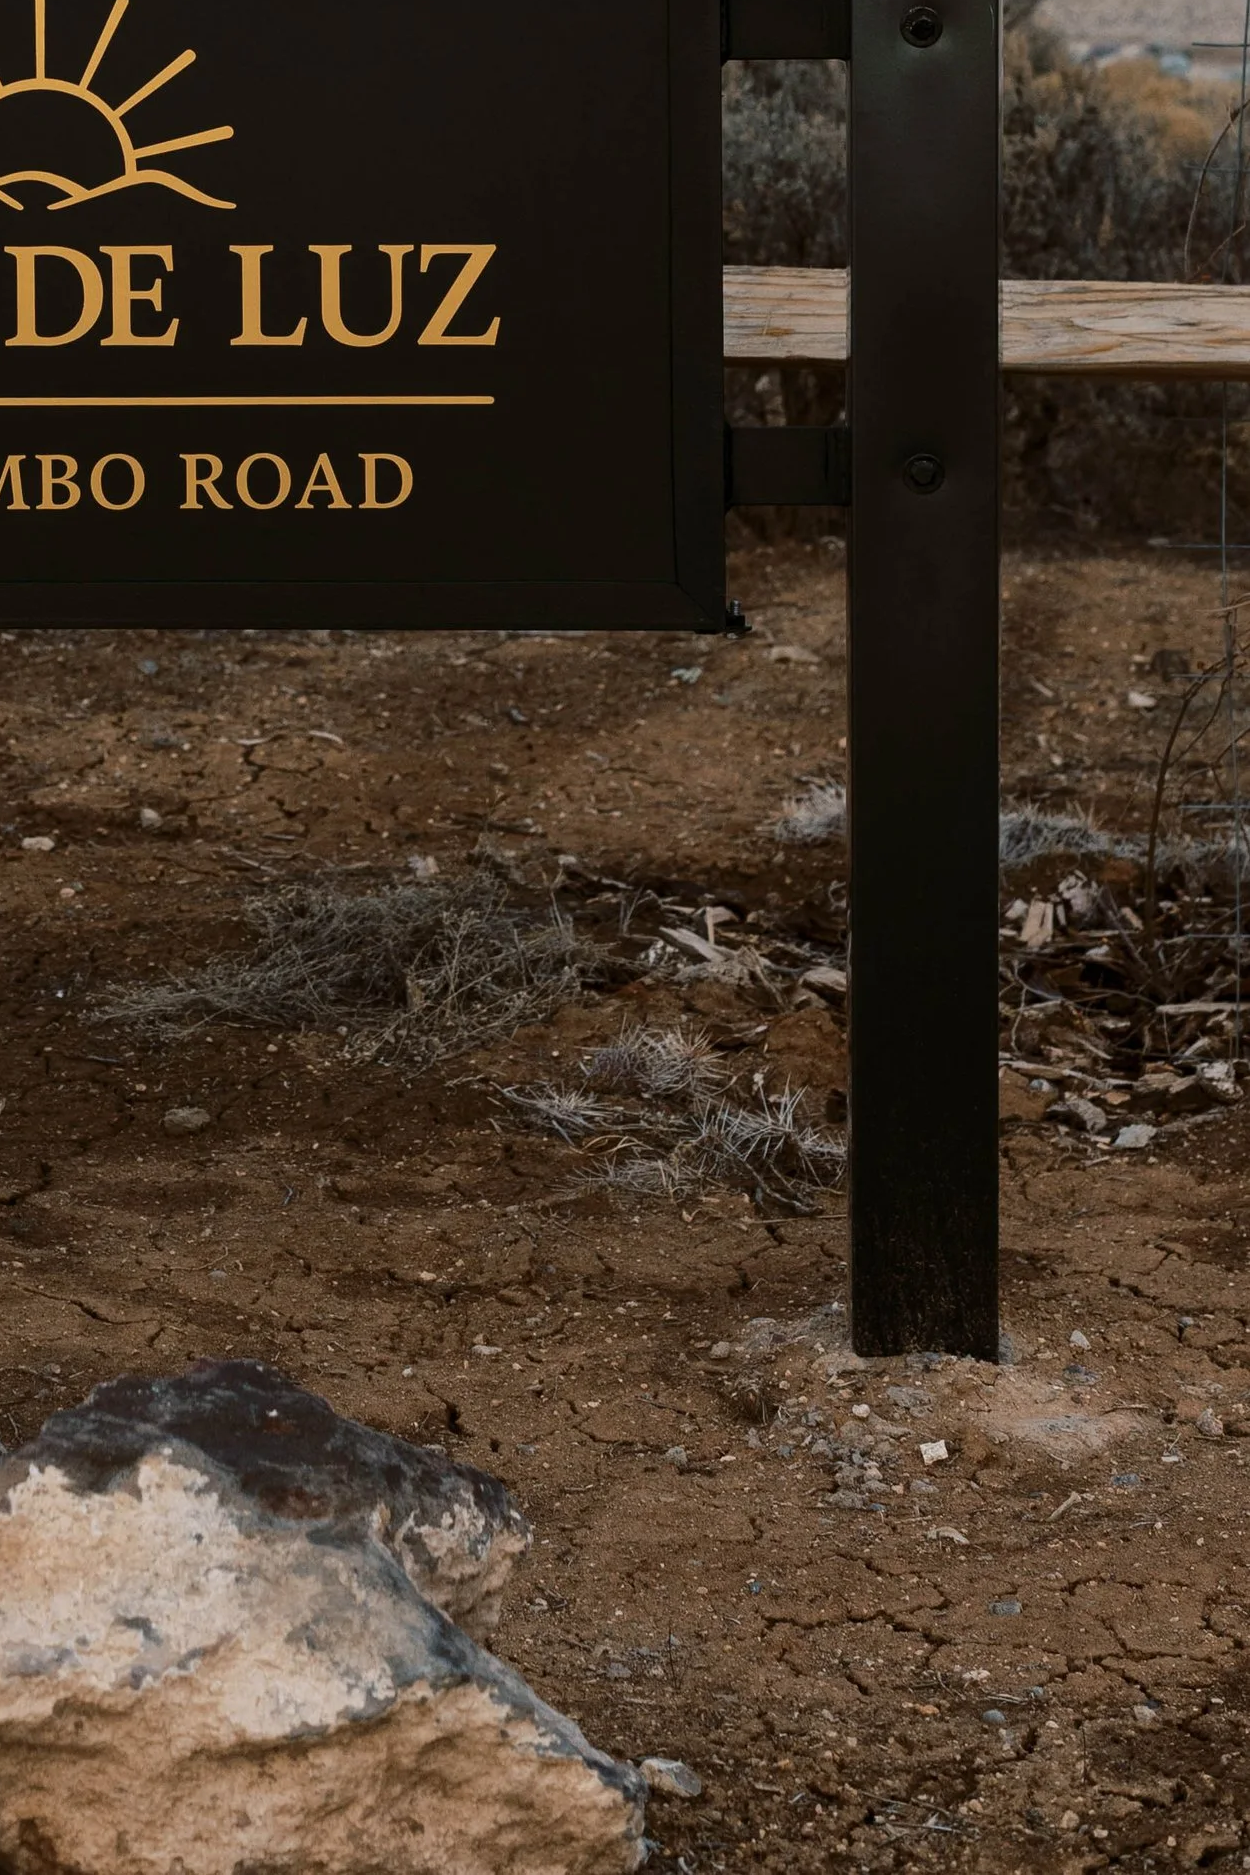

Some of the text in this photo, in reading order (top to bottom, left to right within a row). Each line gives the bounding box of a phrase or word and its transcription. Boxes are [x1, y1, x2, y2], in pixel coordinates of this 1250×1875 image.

[3, 244, 180, 348] DE
[228, 243, 502, 348] LUZ
[179, 452, 414, 511] ROAD
